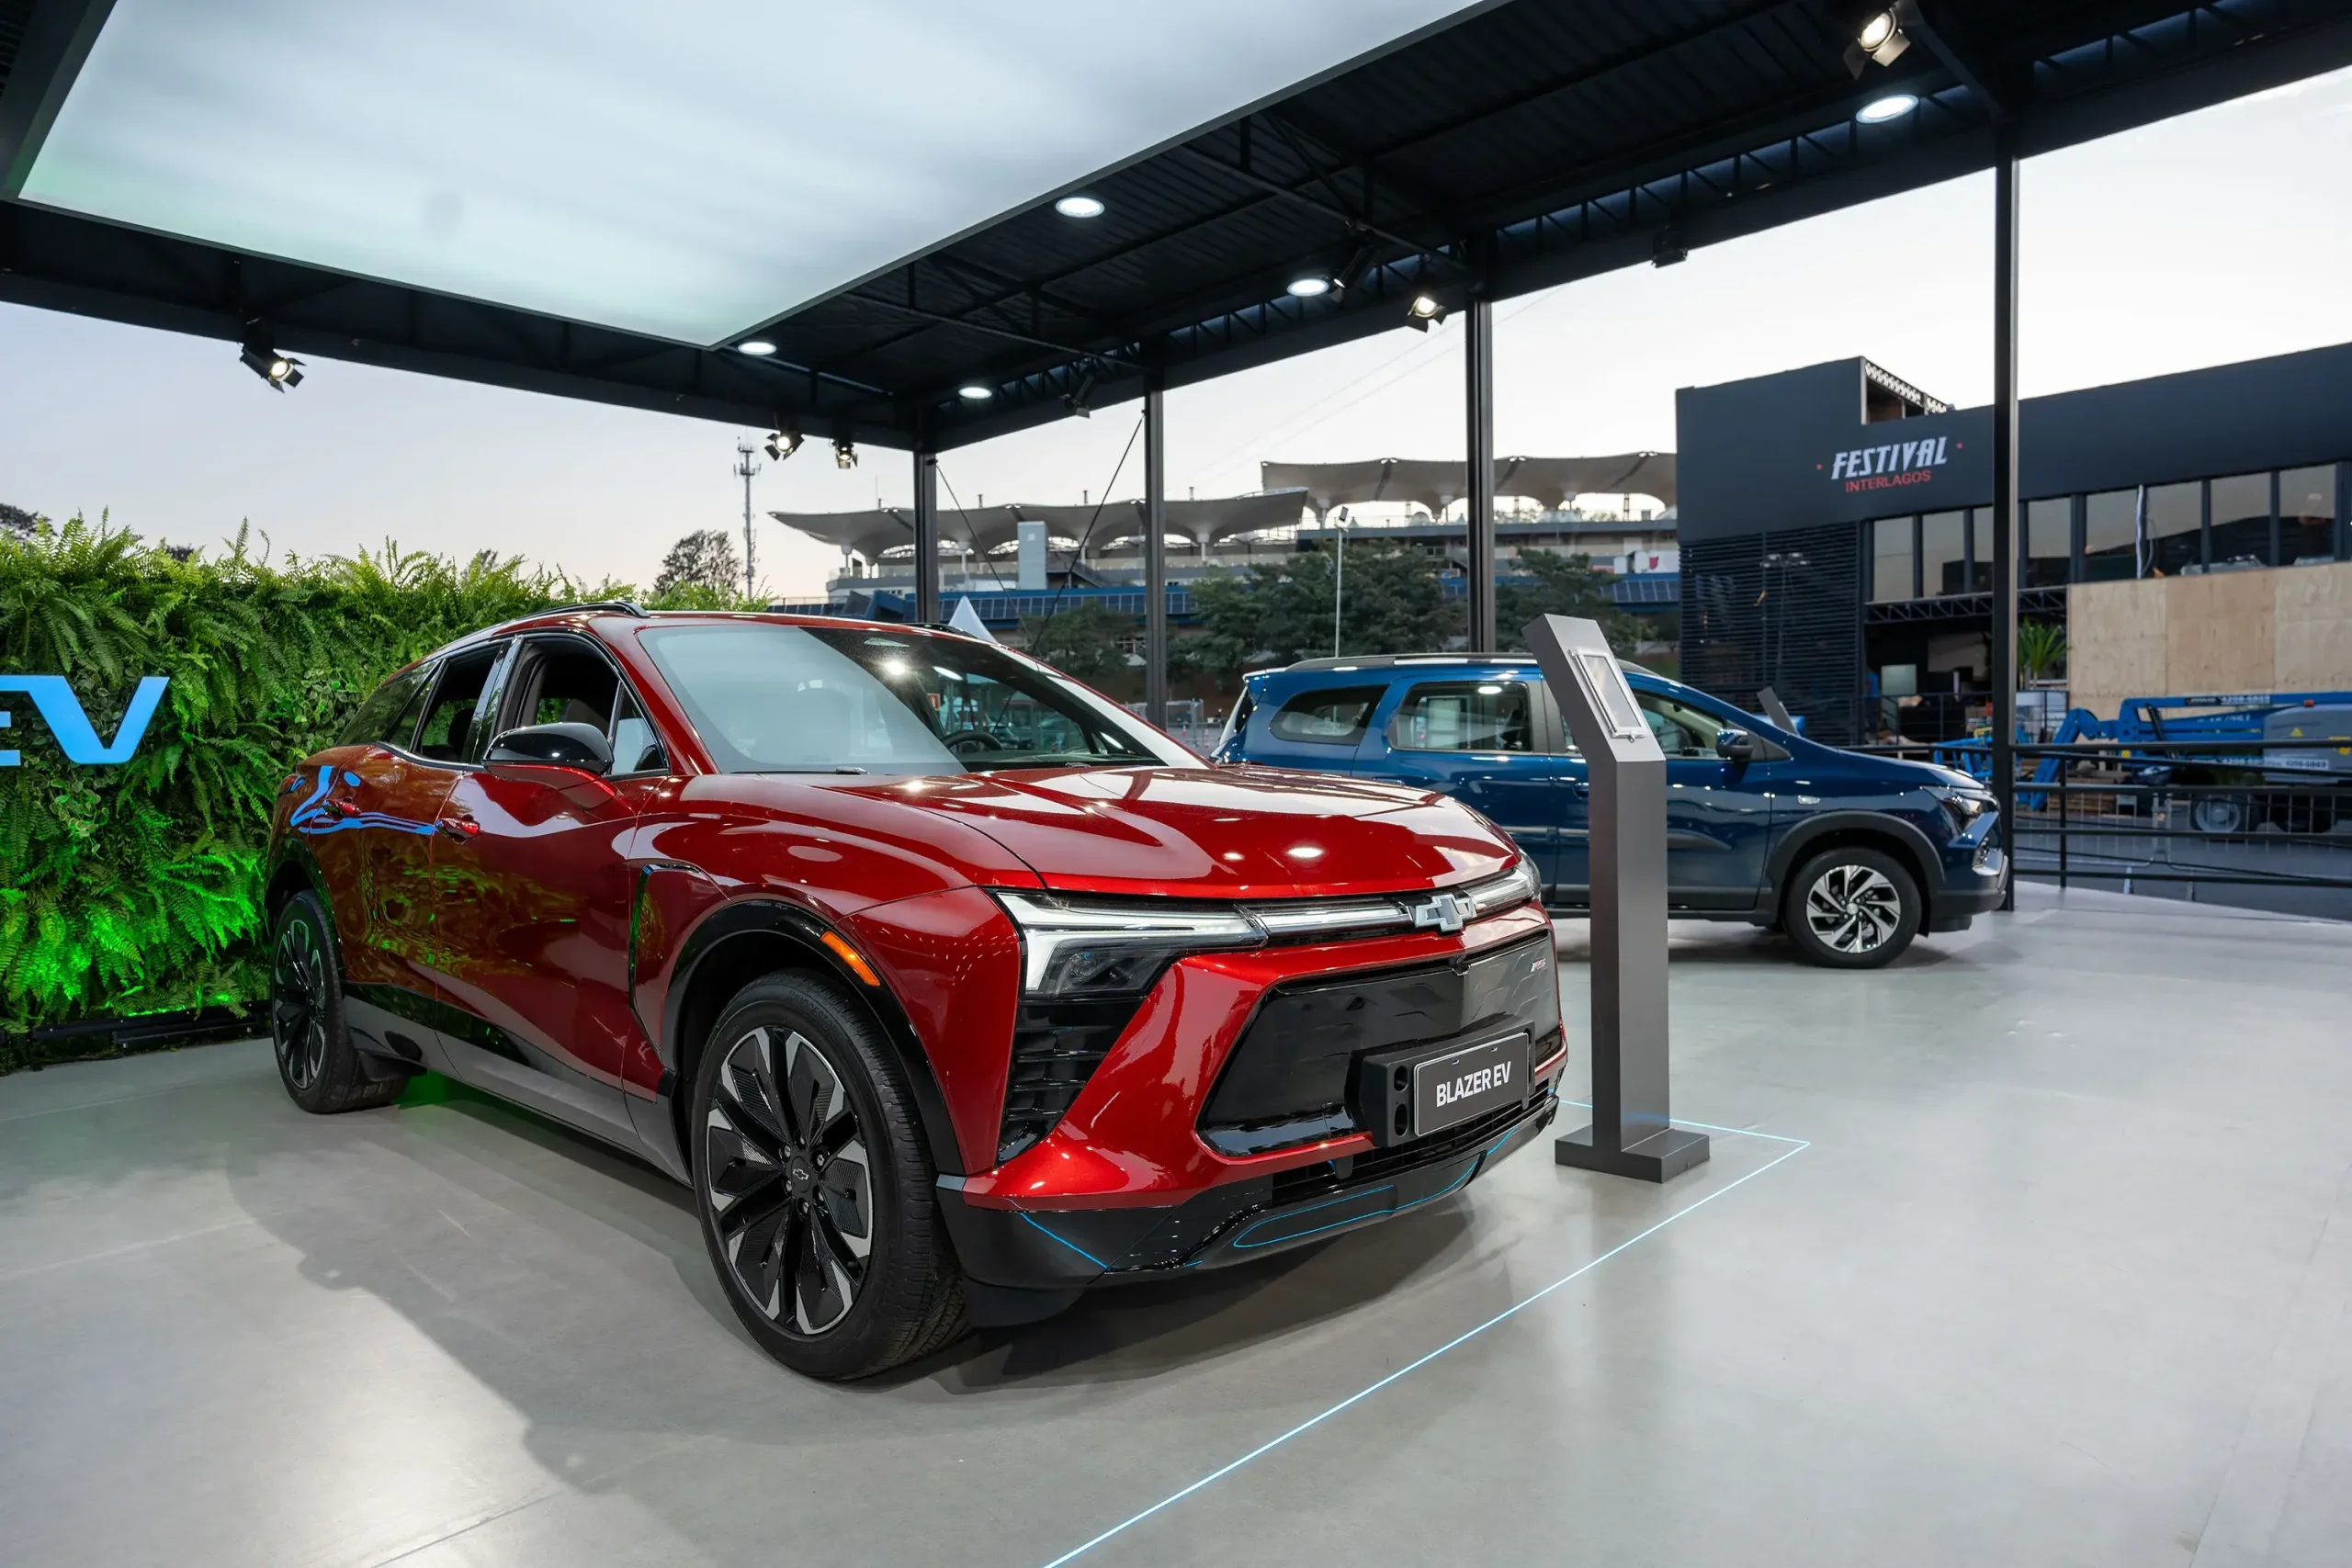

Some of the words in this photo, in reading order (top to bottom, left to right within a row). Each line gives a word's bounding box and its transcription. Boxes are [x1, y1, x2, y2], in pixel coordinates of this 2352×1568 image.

[1830, 436, 1948, 479] FESTIVAL
[1845, 469, 1932, 492] INTERLAGOS
[787, 989, 843, 1040] BRIDGESTO
[1436, 1070, 1492, 1108] BLAZER
[1493, 1061, 1511, 1088] EV
